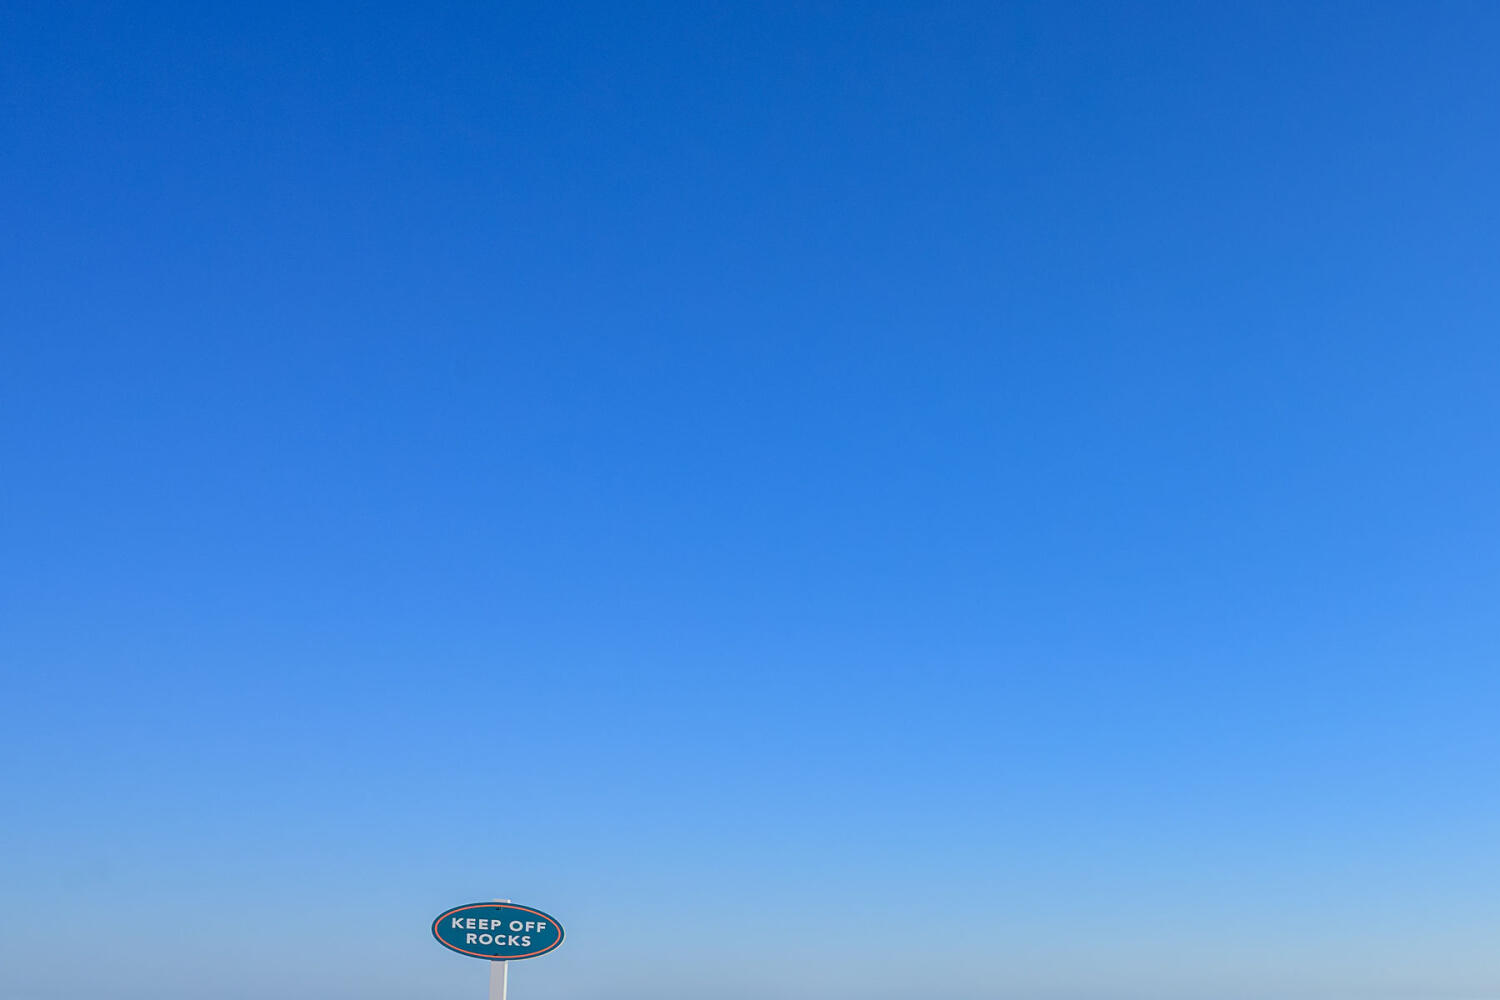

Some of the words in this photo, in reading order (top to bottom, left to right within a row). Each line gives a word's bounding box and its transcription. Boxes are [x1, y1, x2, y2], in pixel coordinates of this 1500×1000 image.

[451, 917, 502, 931] KEEP
[509, 920, 547, 933] OFF
[466, 933, 532, 947] ROCKS
